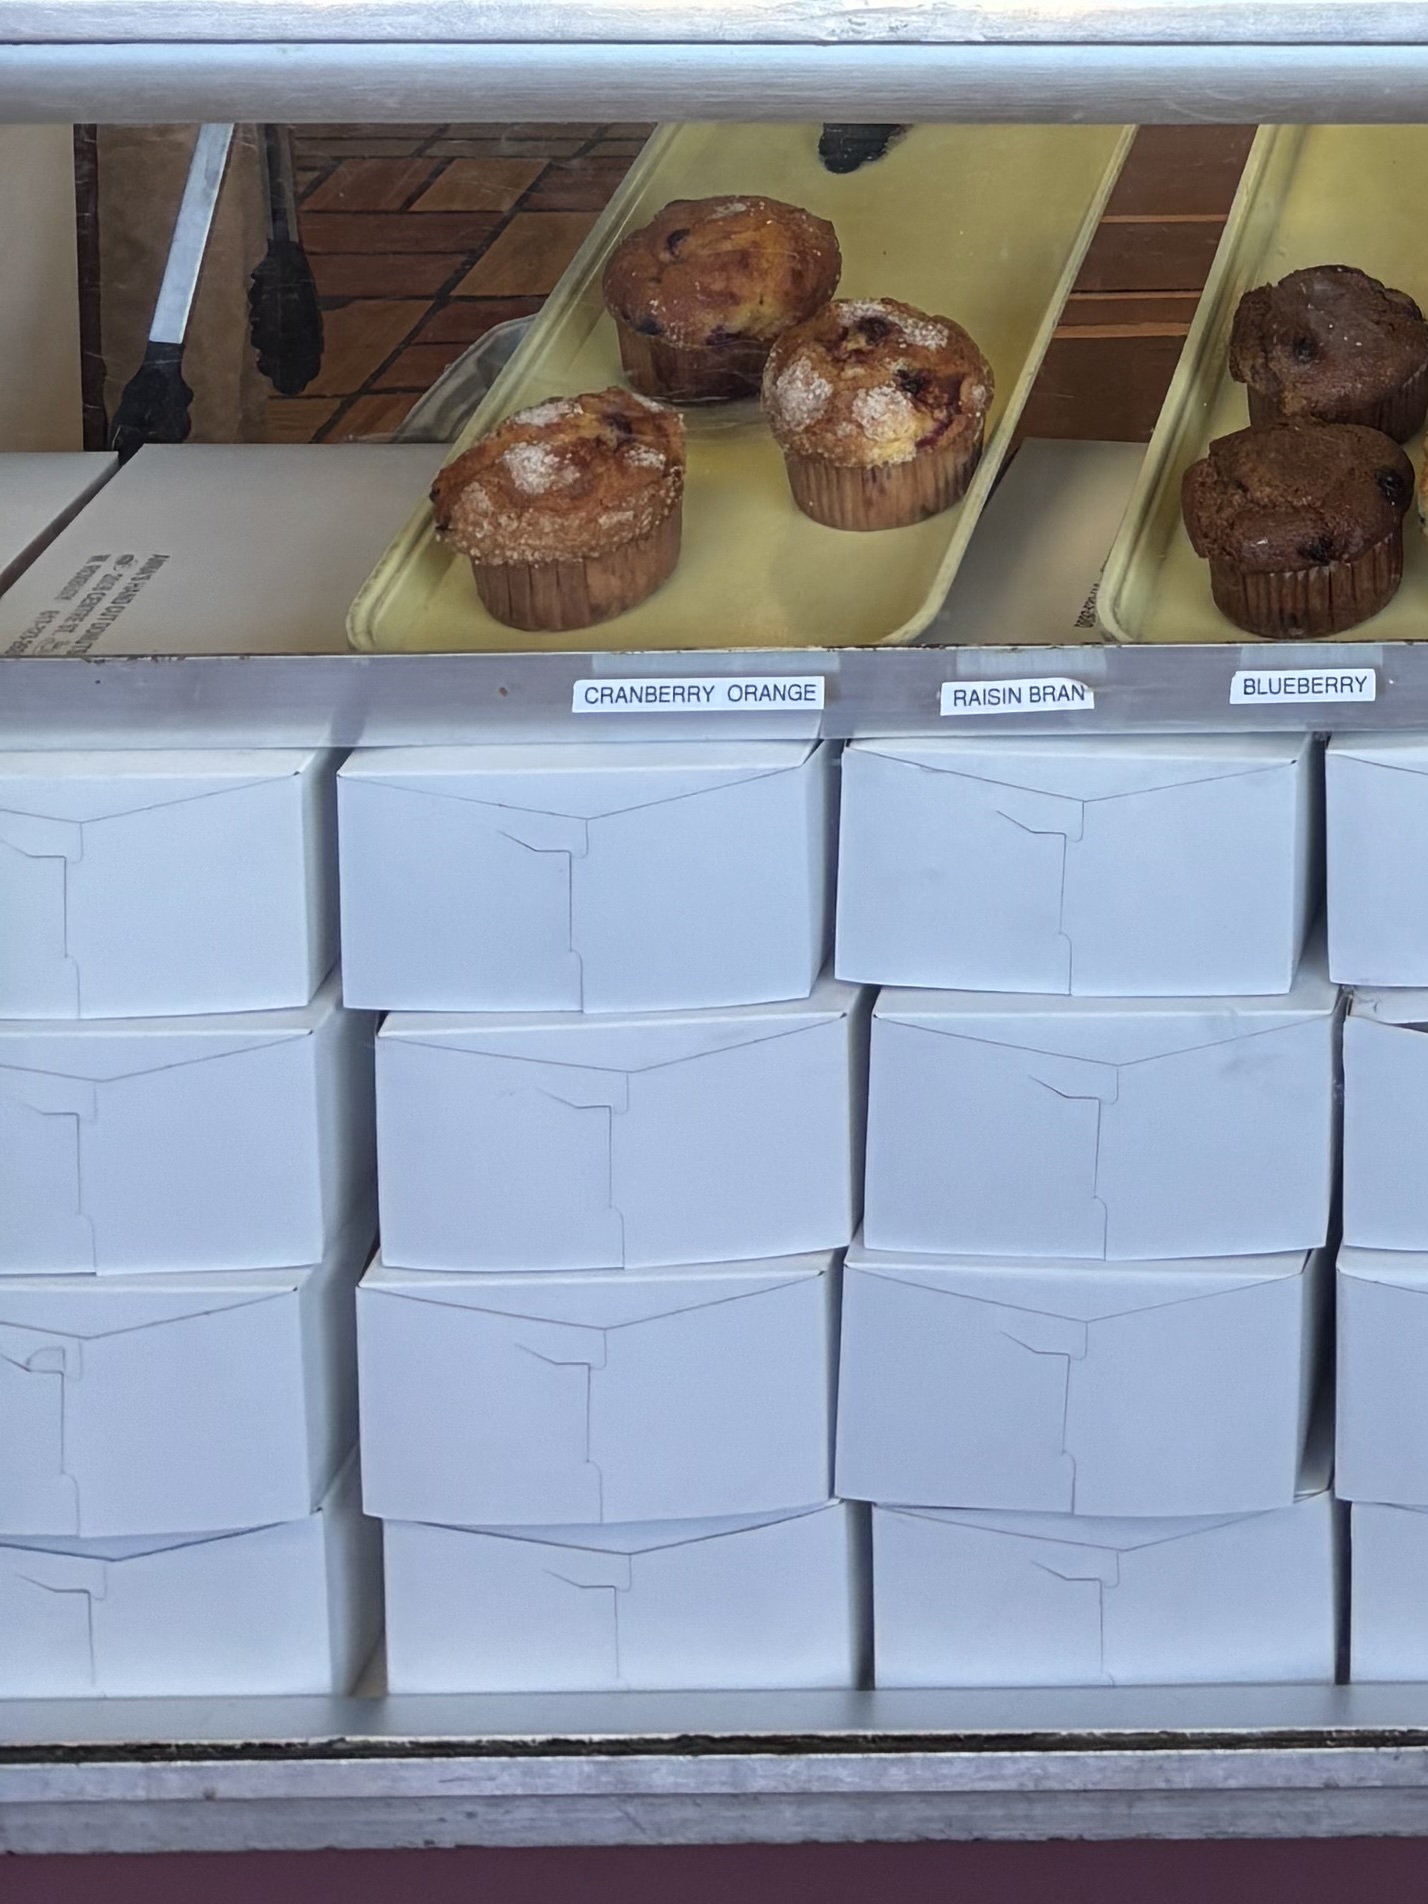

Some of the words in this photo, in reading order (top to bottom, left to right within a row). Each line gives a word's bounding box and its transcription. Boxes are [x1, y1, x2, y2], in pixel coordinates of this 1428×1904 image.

[583, 685, 715, 706] CRANBERRY
[726, 683, 817, 704] ORANGE
[952, 686, 1021, 707] RAISIN
[1028, 683, 1086, 704] BRAN
[1242, 676, 1368, 697] BLUEBERRY
